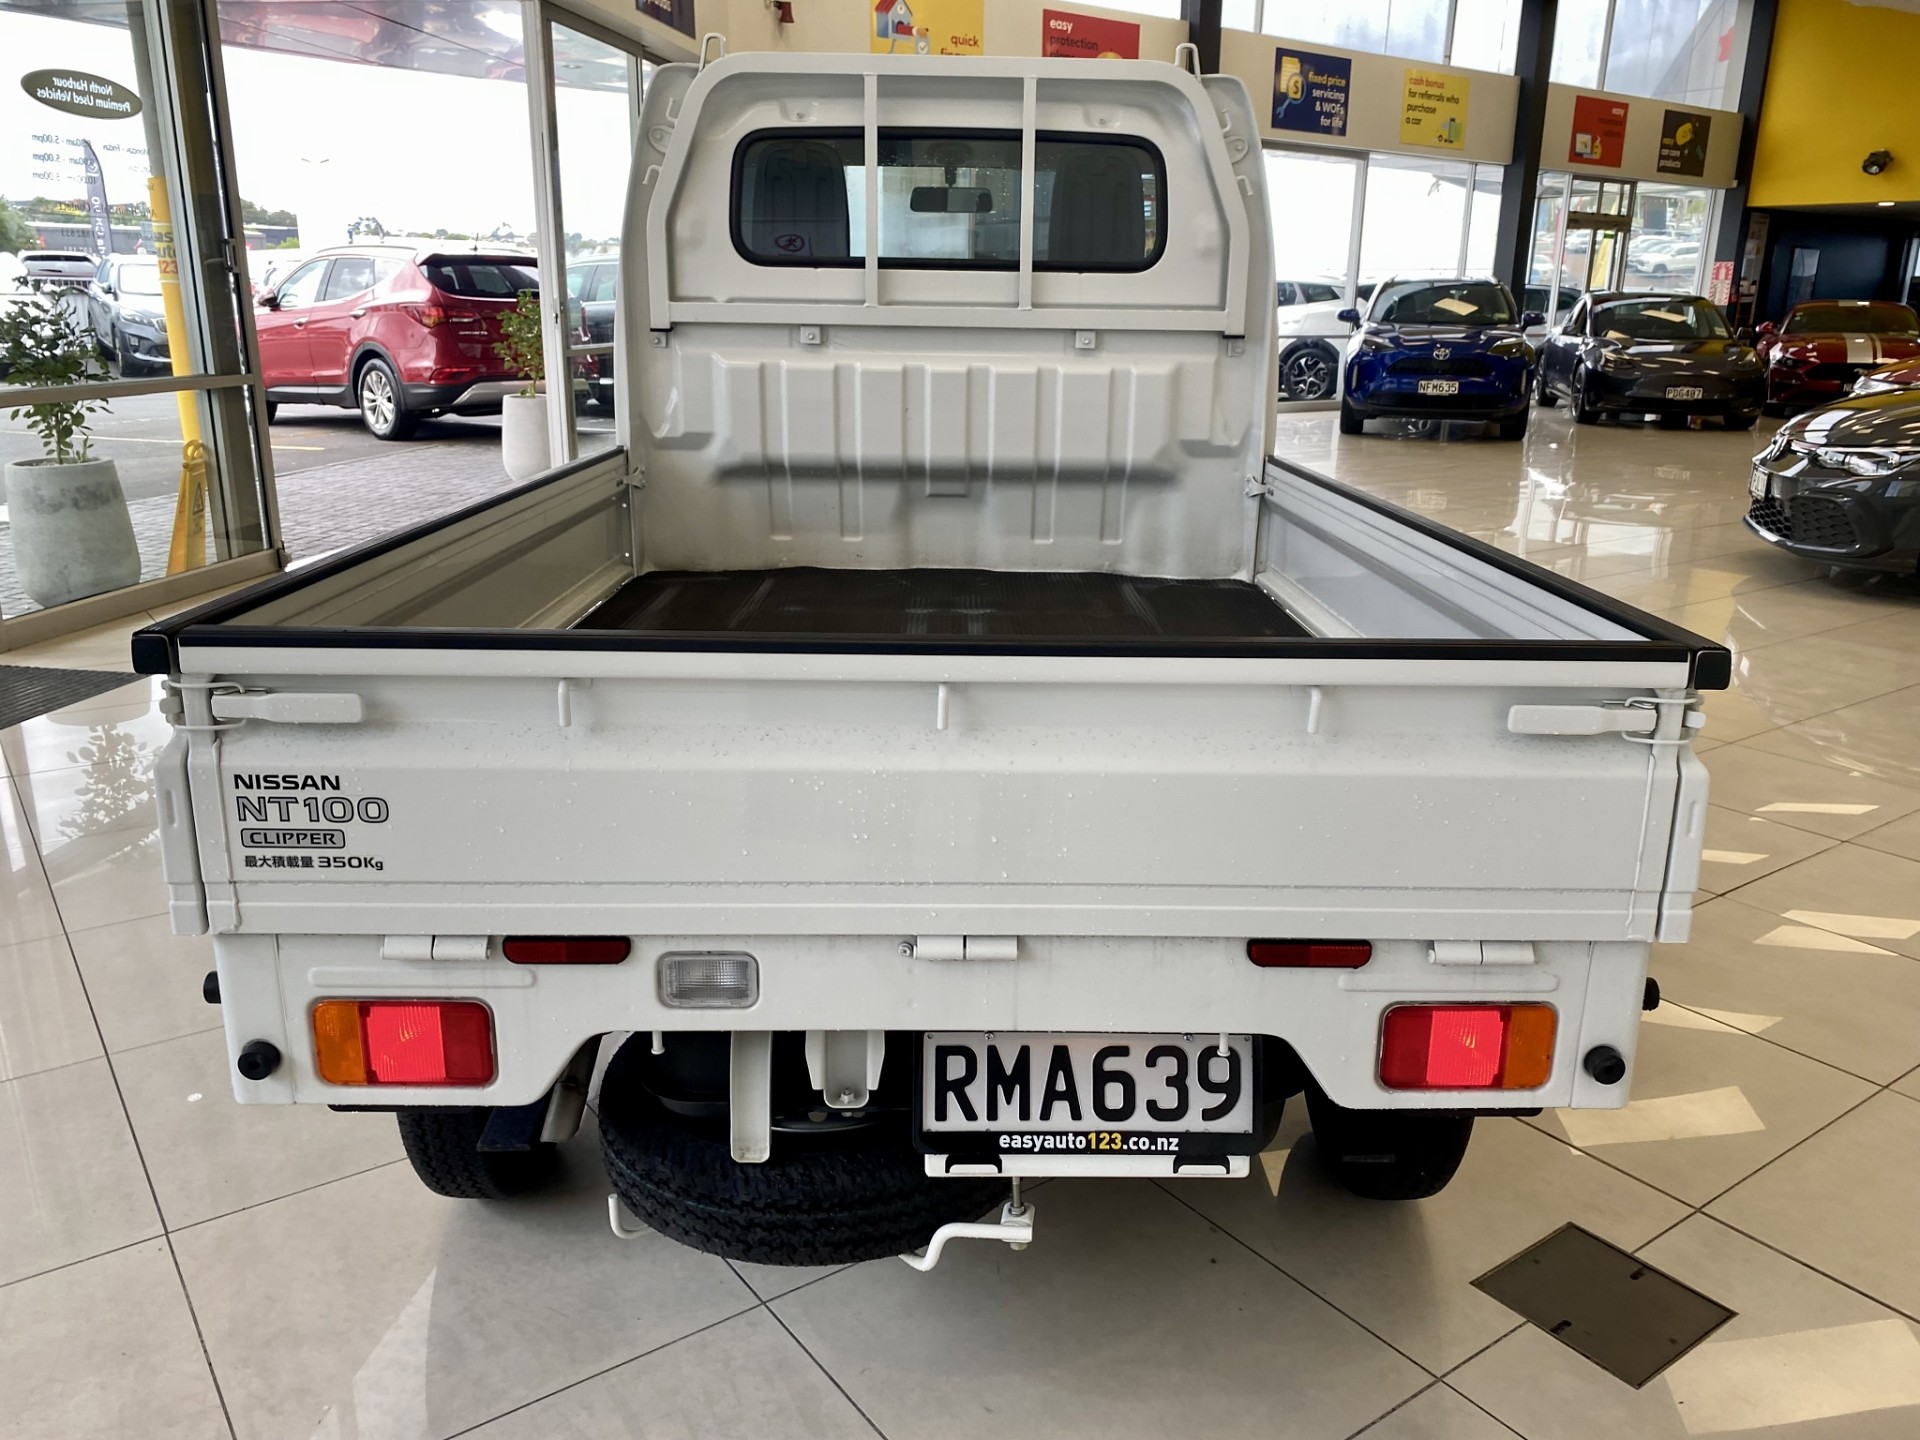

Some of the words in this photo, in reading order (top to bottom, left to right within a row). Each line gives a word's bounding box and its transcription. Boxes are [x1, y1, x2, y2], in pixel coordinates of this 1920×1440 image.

[1050, 19, 1073, 34] easy
[951, 34, 979, 48] quick
[1050, 36, 1098, 51] protection
[1309, 71, 1327, 84] fixed
[1327, 75, 1346, 87] price
[1409, 77, 1424, 86] cash
[1425, 78, 1444, 89] bonus
[1312, 88, 1345, 103] servicing
[1408, 88, 1417, 98] for
[1418, 90, 1444, 102] referrals
[1446, 94, 1459, 104] who
[1315, 101, 1321, 112] &
[1322, 102, 1344, 115] WOFs
[1407, 103, 1436, 114] purchase
[1320, 115, 1330, 126] for
[1332, 116, 1343, 128] life
[1411, 117, 1422, 125] car
[1420, 382, 1457, 393] NFM635
[233, 774, 340, 790] NISSAN
[236, 796, 389, 823] NT100
[250, 832, 336, 845] CLIPPER
[934, 1045, 1241, 1122] RMA639
[999, 1132, 1180, 1153] easyauto123.co.nz
